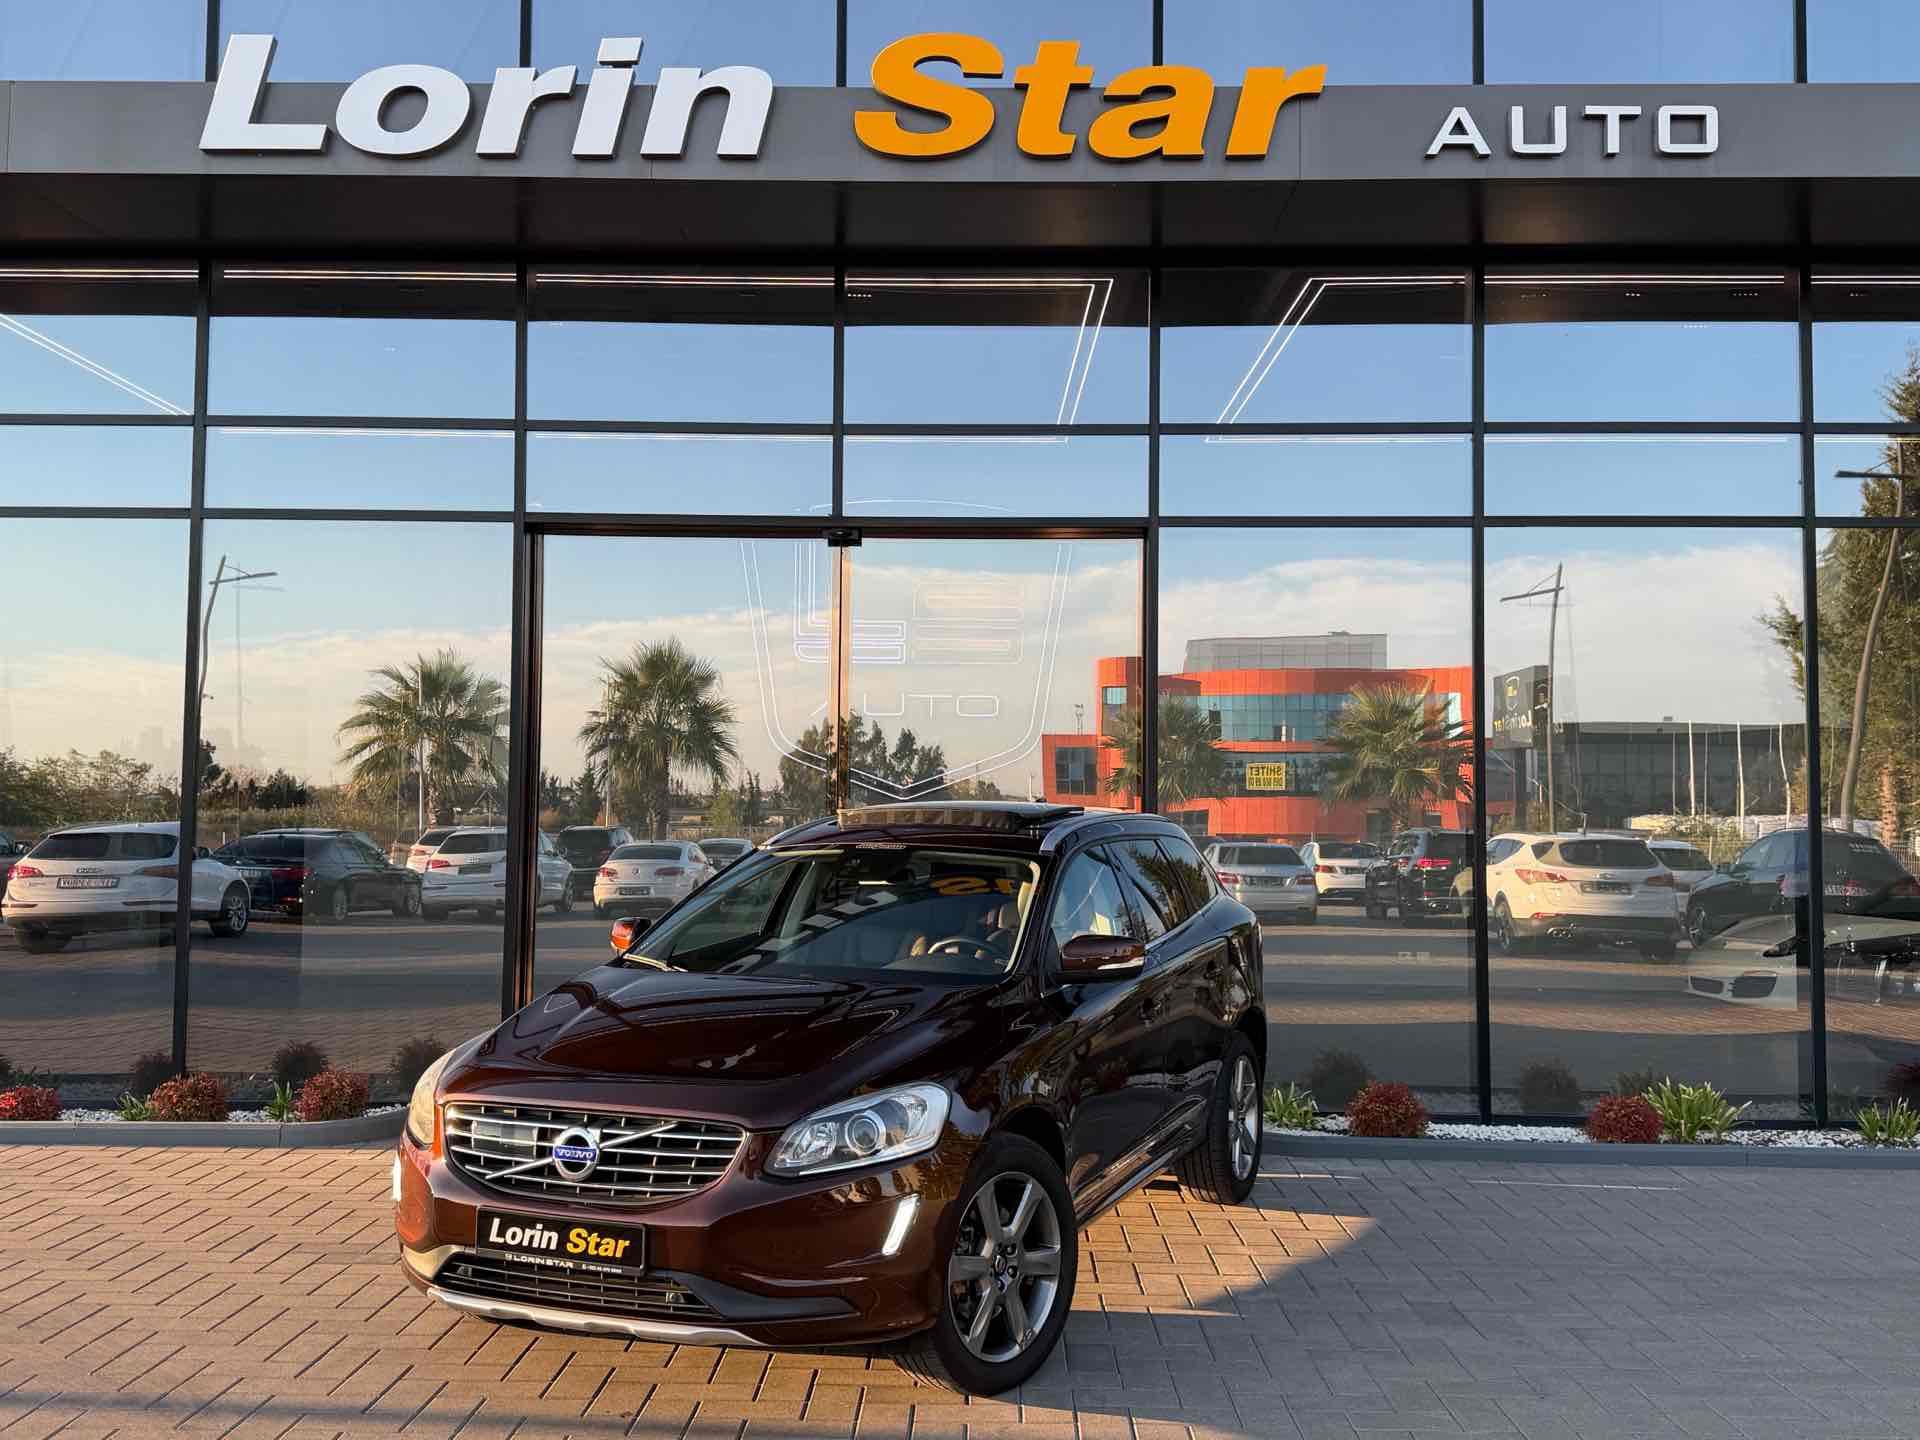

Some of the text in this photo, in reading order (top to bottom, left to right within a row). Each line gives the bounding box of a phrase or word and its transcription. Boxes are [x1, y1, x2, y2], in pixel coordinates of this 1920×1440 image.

[200, 32, 1719, 161] Lorin Star AUTO
[557, 1148, 593, 1159] VOLVO
[489, 1217, 630, 1258] Lorin Star
[513, 1254, 545, 1267] LORIN
[546, 1259, 574, 1270] STAR
